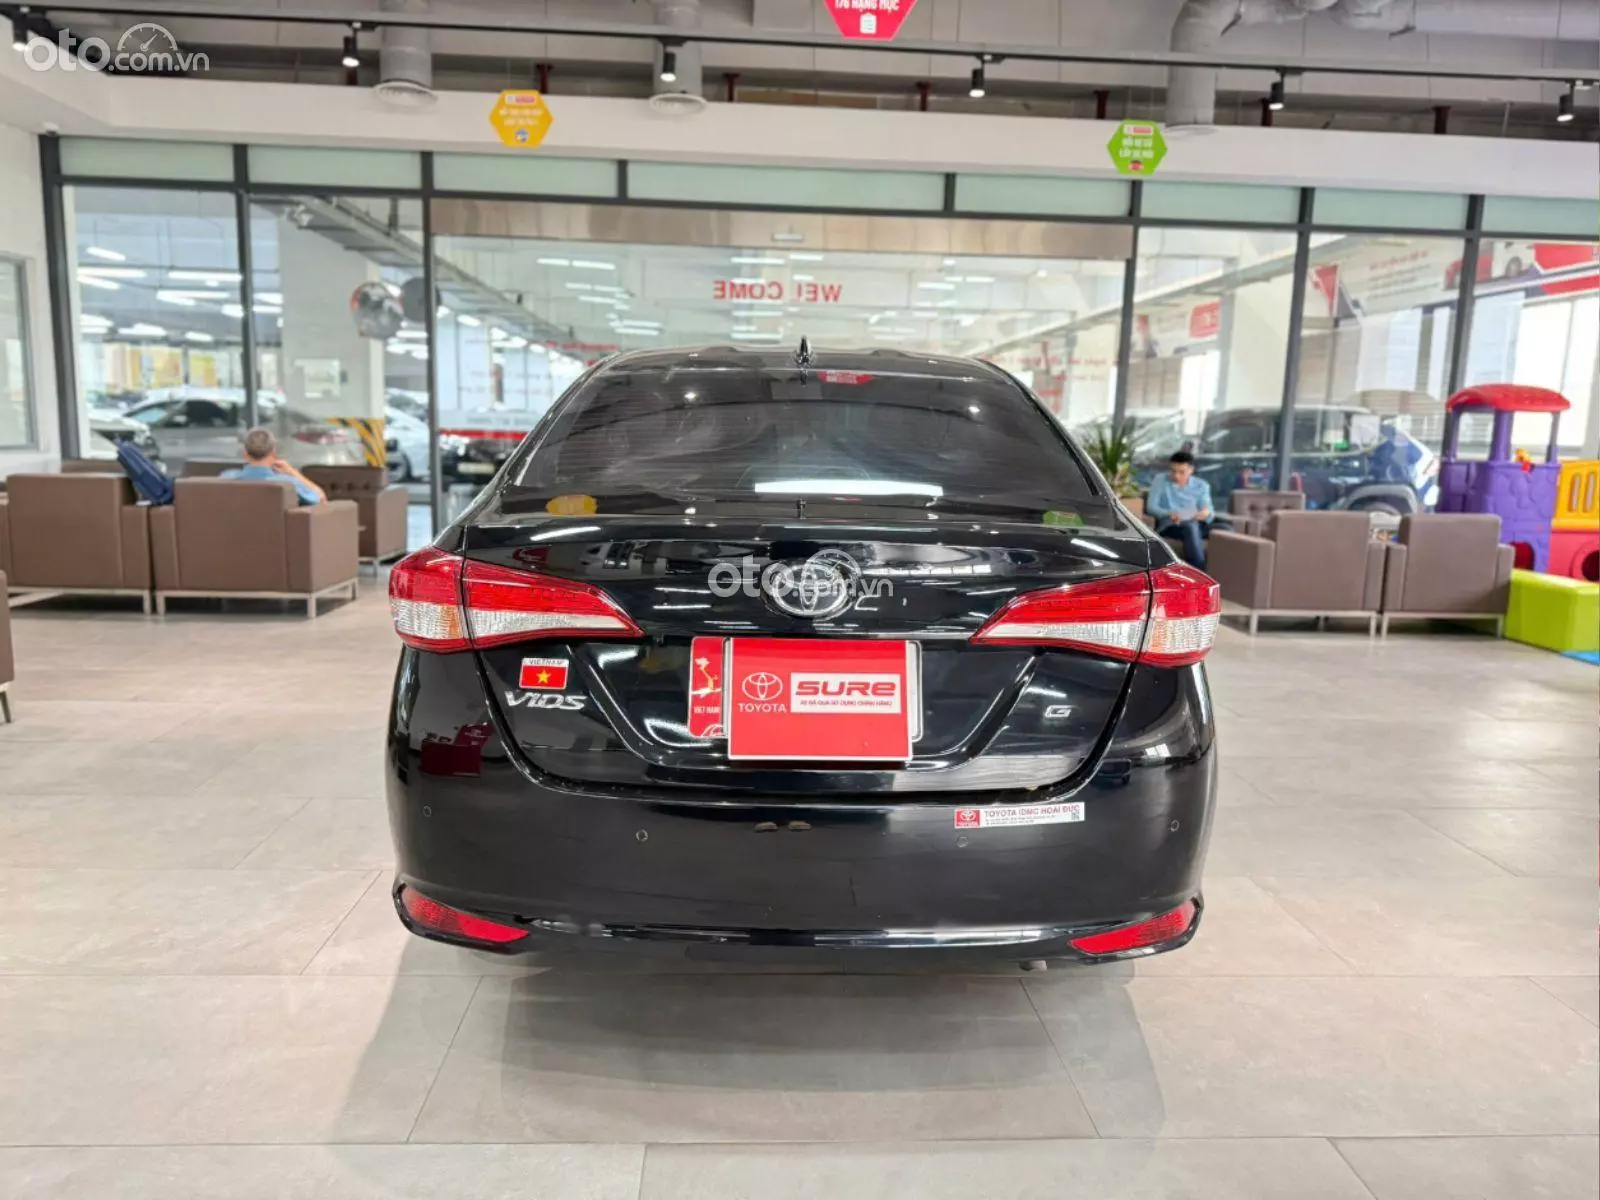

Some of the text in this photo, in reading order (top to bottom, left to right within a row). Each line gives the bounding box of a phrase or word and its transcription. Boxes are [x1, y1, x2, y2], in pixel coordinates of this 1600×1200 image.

[504, 691, 588, 710] VIOS
[738, 702, 788, 713] TOYOTA
[984, 810, 1017, 818] TOYOTA
